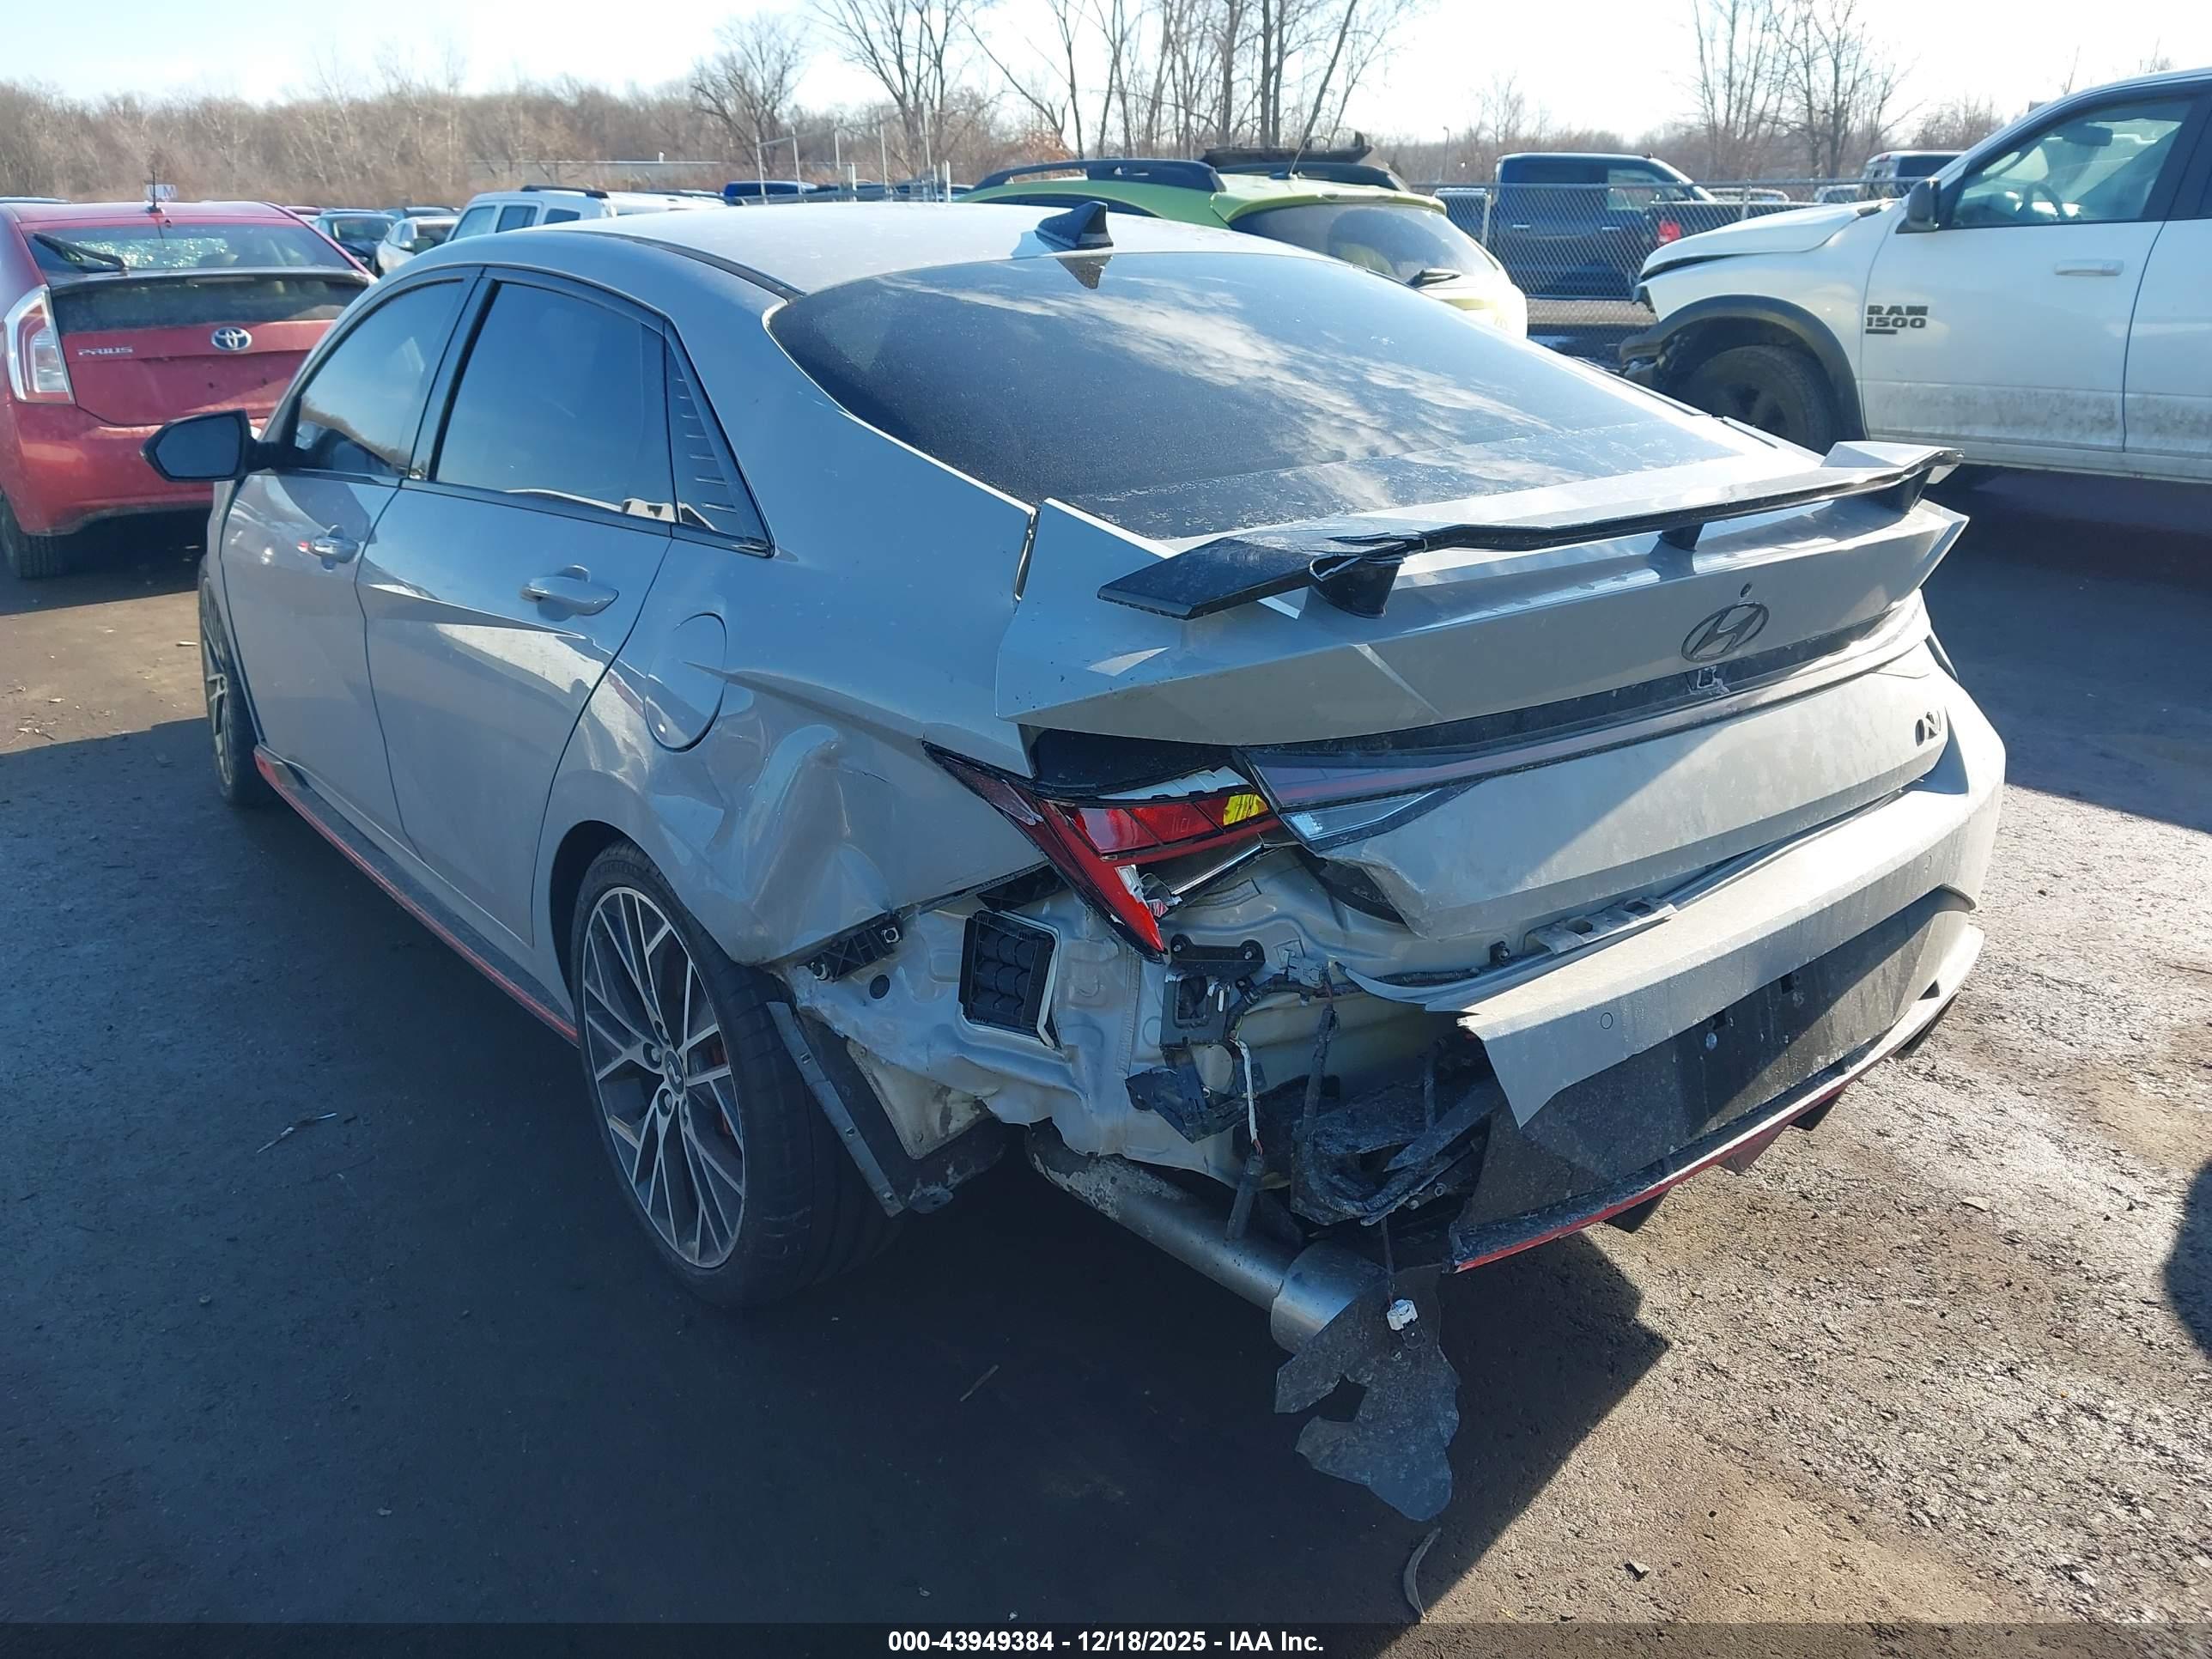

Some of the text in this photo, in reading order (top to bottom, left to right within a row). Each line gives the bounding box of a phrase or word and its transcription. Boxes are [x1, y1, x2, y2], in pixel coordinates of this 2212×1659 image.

[1867, 305, 1929, 316] RAM
[1866, 316, 1926, 328] 1500
[77, 346, 133, 356] PRIUS
